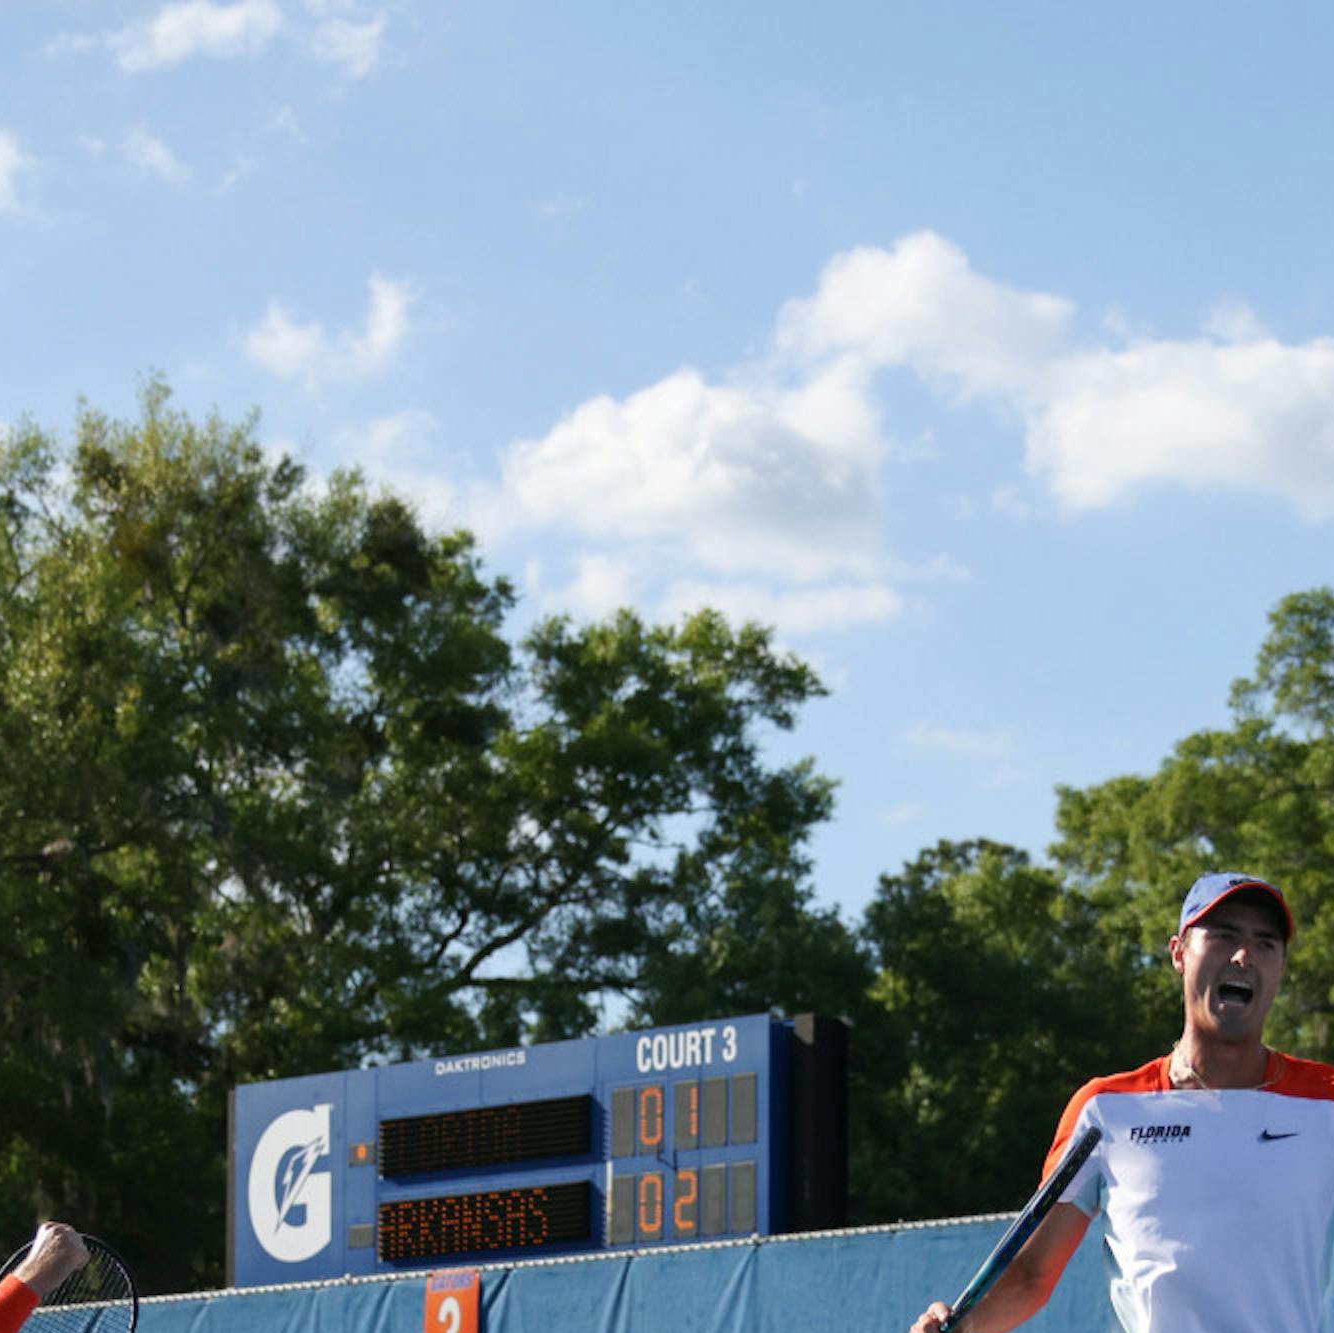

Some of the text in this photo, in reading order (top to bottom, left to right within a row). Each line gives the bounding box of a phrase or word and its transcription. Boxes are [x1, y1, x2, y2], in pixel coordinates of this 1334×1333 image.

[435, 1051, 527, 1076] DAKTRONICS
[636, 1025, 738, 1073] COURT 3
[1130, 1125, 1192, 1141] FLORIDA
[248, 1104, 332, 1263] G
[379, 1187, 548, 1260] ARKANSAS
